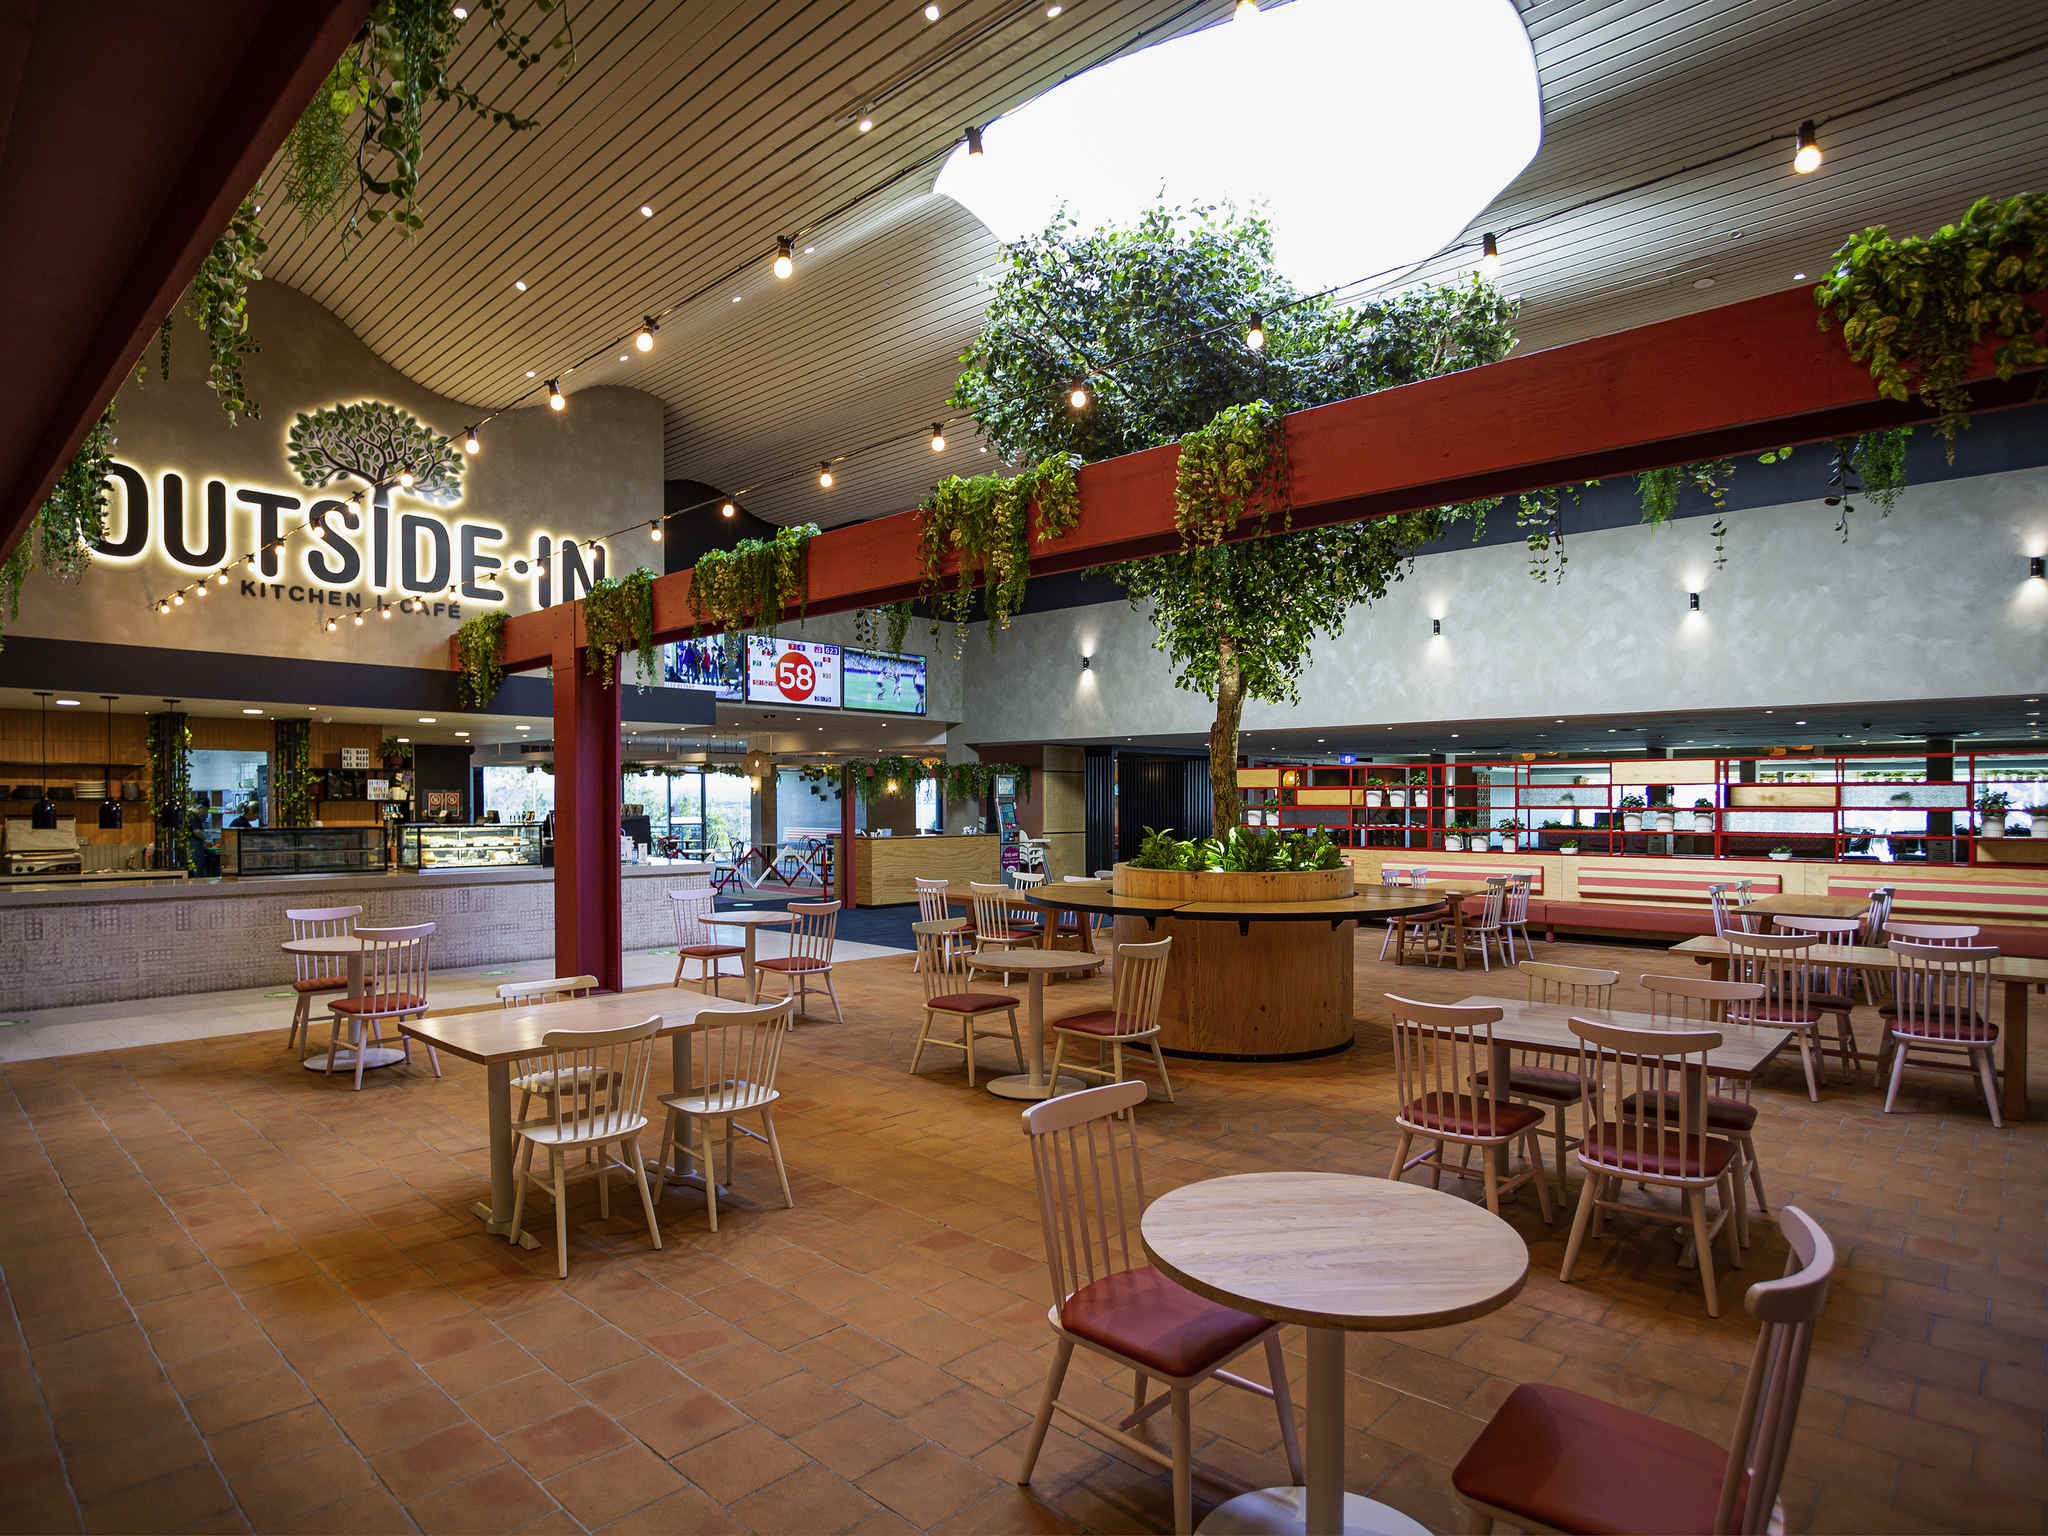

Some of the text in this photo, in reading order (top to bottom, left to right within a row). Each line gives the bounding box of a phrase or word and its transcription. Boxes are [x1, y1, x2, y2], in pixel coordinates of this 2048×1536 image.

[240, 579, 361, 608] KITCHEN
[399, 599, 461, 619] CAFÉ
[779, 661, 813, 691] 58
